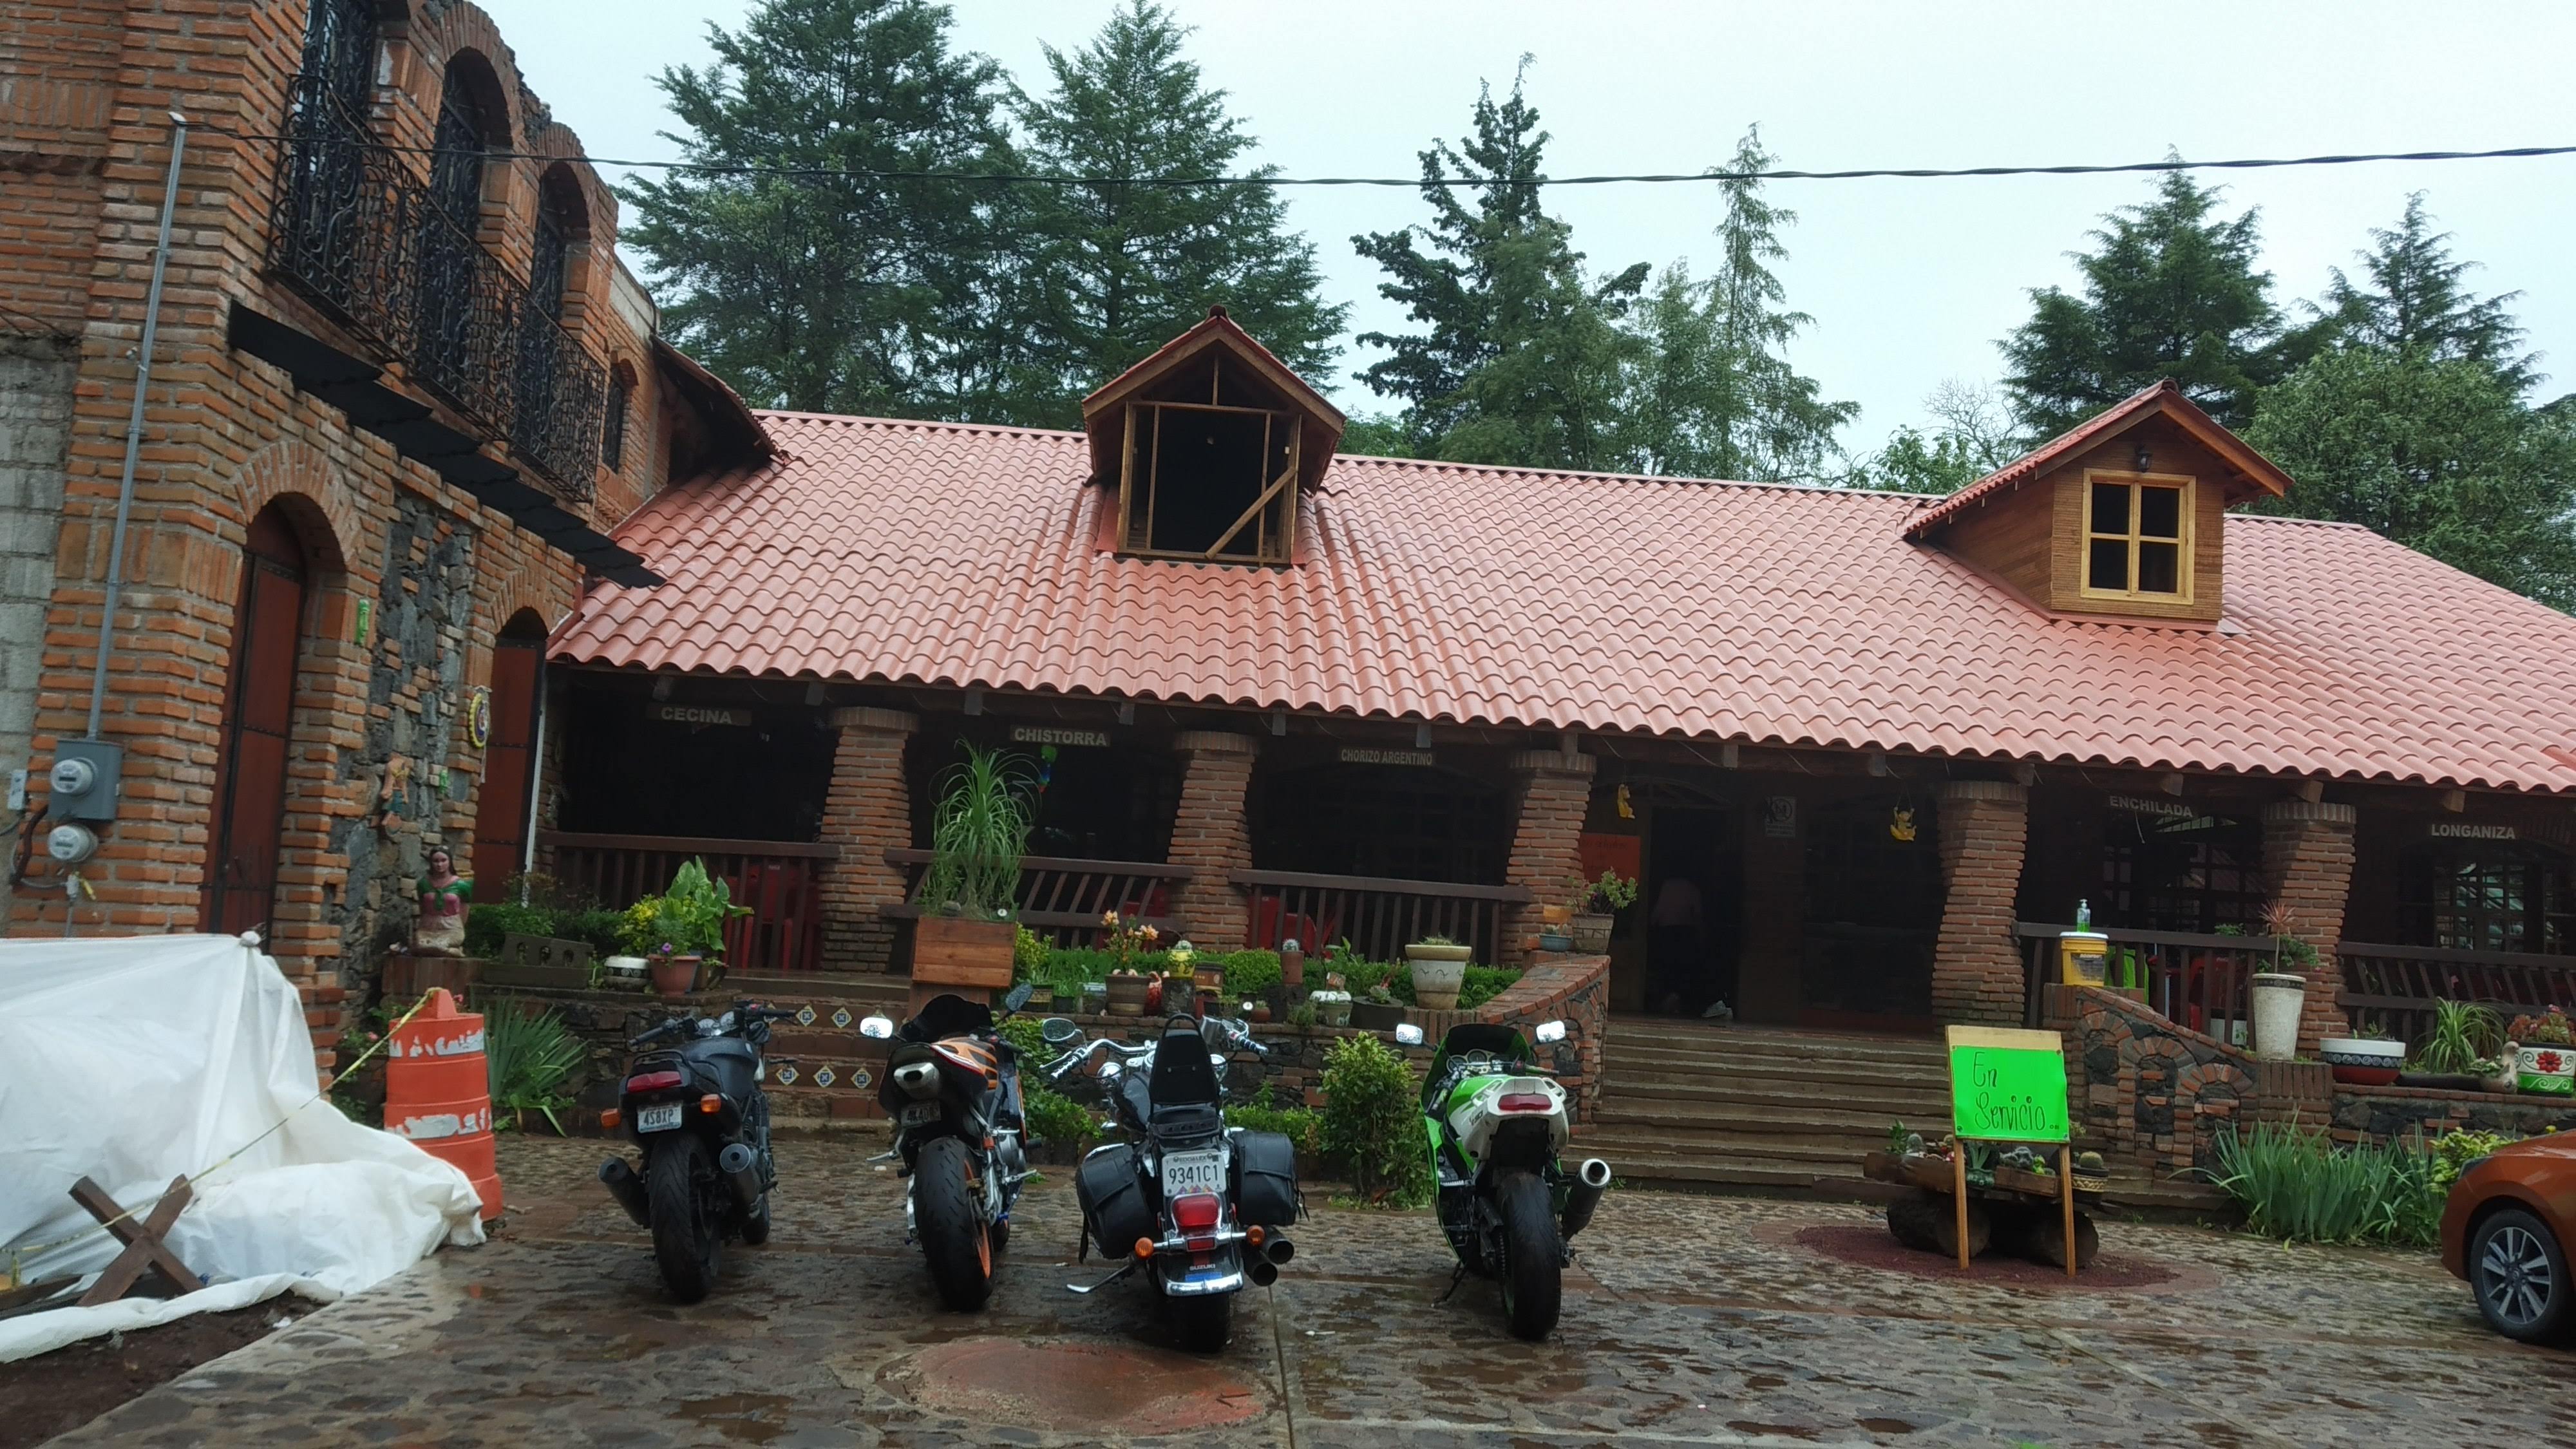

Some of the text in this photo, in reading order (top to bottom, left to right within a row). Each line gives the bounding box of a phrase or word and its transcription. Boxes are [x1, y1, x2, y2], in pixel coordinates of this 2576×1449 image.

[661, 706, 732, 724] CECINA
[1014, 728, 1107, 746] CHISTORRA
[1341, 749, 1433, 766] CHORIZO ARGENTINO
[2110, 795, 2193, 818] ENCHILADA
[2431, 824, 2515, 839] LONGANIZA
[1973, 1051, 1997, 1088] En
[1169, 1164, 1218, 1184] 9341C1
